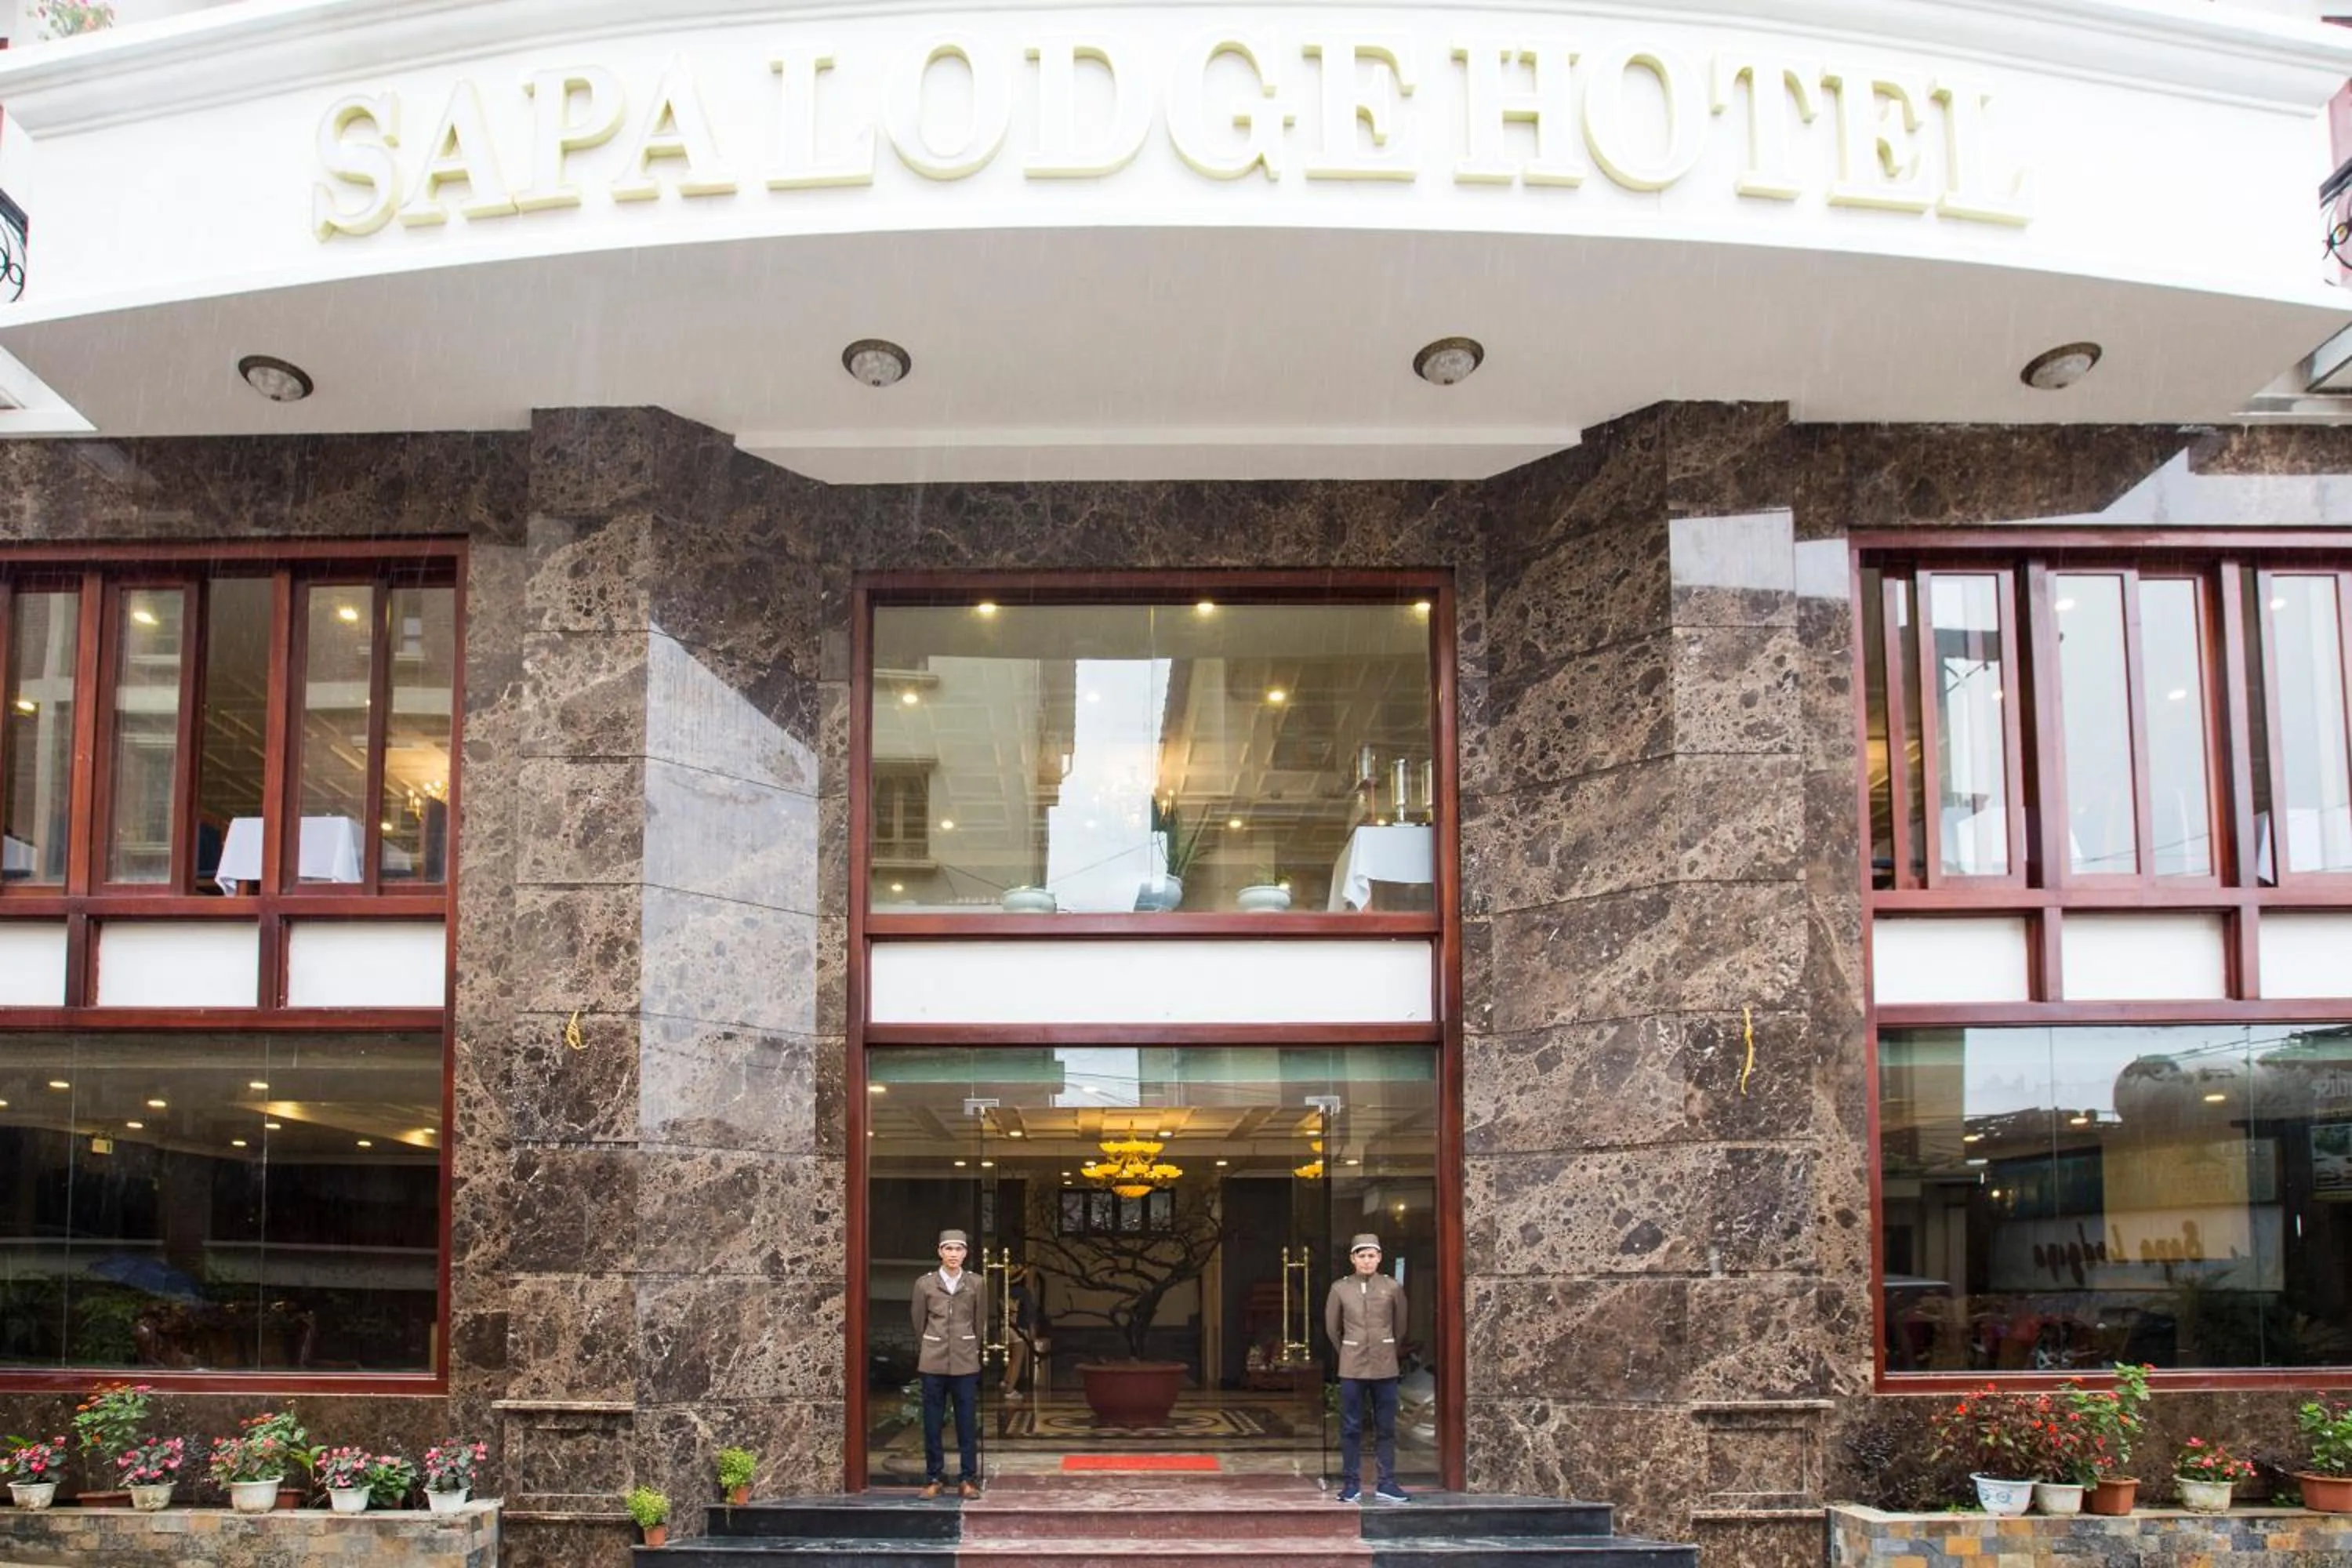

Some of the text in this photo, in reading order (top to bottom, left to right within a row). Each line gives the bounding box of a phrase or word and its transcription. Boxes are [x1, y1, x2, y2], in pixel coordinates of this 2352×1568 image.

[311, 28, 2037, 243] SAPA LODGE HOTEL
